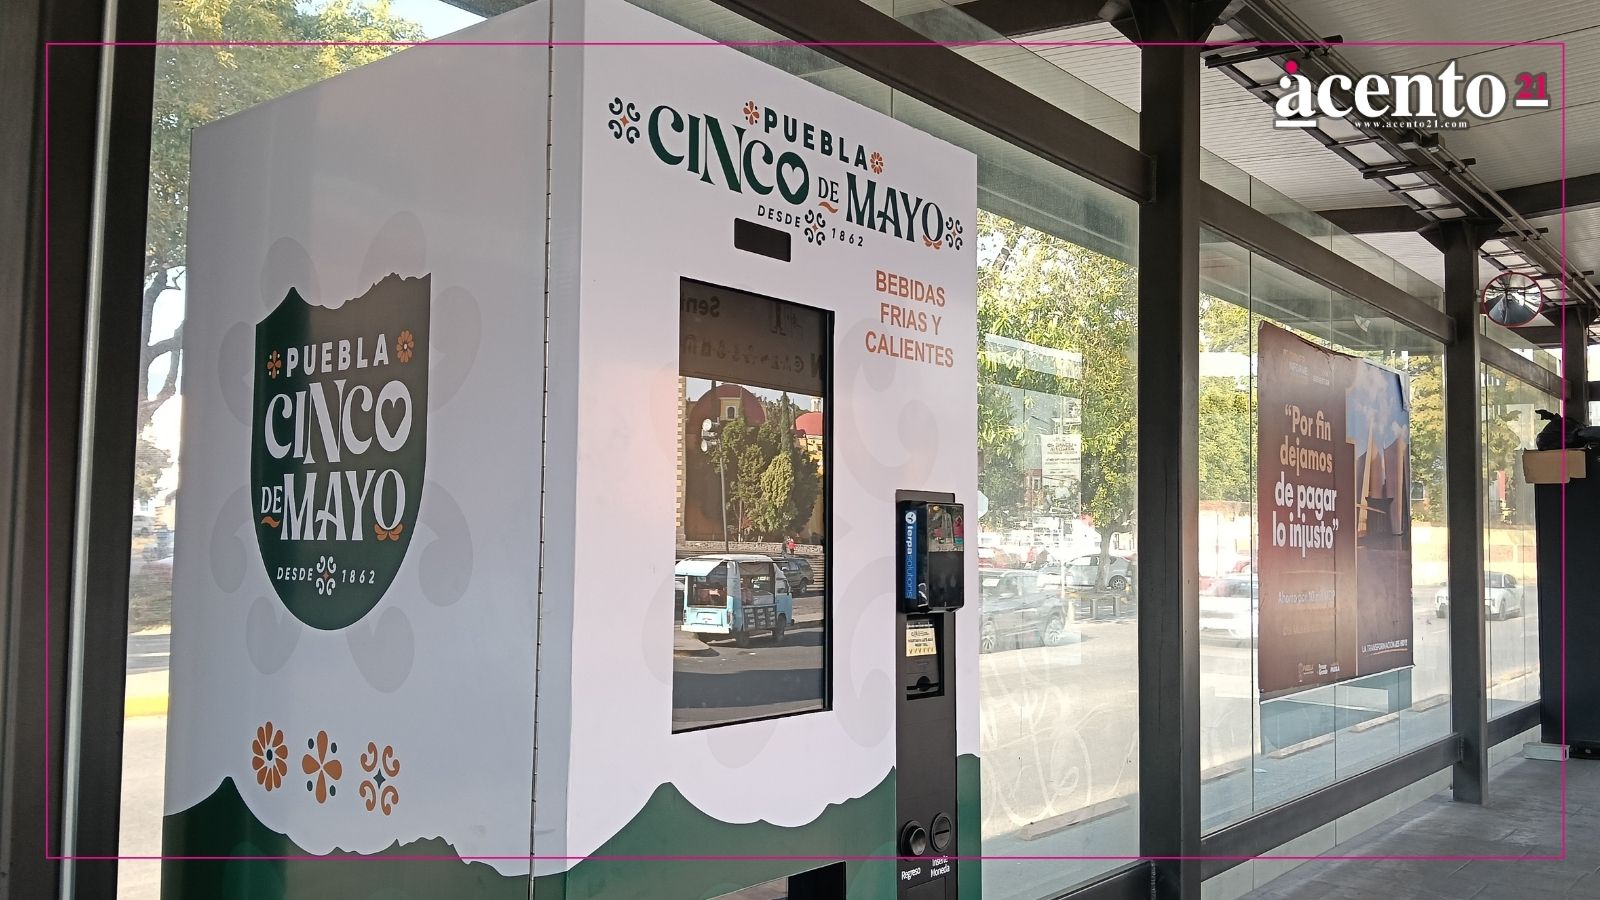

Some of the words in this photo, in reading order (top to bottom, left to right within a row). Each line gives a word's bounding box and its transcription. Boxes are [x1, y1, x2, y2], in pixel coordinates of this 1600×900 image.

[764, 107, 868, 170] PUEBLA
[648, 105, 810, 205] CINCO
[818, 176, 839, 203] DE
[846, 172, 944, 242] MAYO
[757, 204, 801, 228] DESDE
[831, 227, 864, 247] 1862
[876, 269, 946, 308] BEBIDAS
[880, 302, 928, 333] FRIAS
[931, 314, 942, 336] Y
[286, 333, 389, 378] PUEBLA
[865, 330, 954, 368] CALIENTES
[264, 379, 413, 465] CINCO
[1316, 410, 1332, 441] fin
[1279, 435, 1333, 477] dejamos
[261, 485, 283, 514] DE
[280, 469, 406, 541] MAYO
[1274, 471, 1294, 508] de
[1297, 484, 1337, 521] pagar
[1272, 511, 1286, 547] lo
[276, 567, 314, 582] DESDE
[341, 569, 375, 584] 1862
[901, 867, 921, 880] Regreso
[930, 863, 950, 878] Moneda
